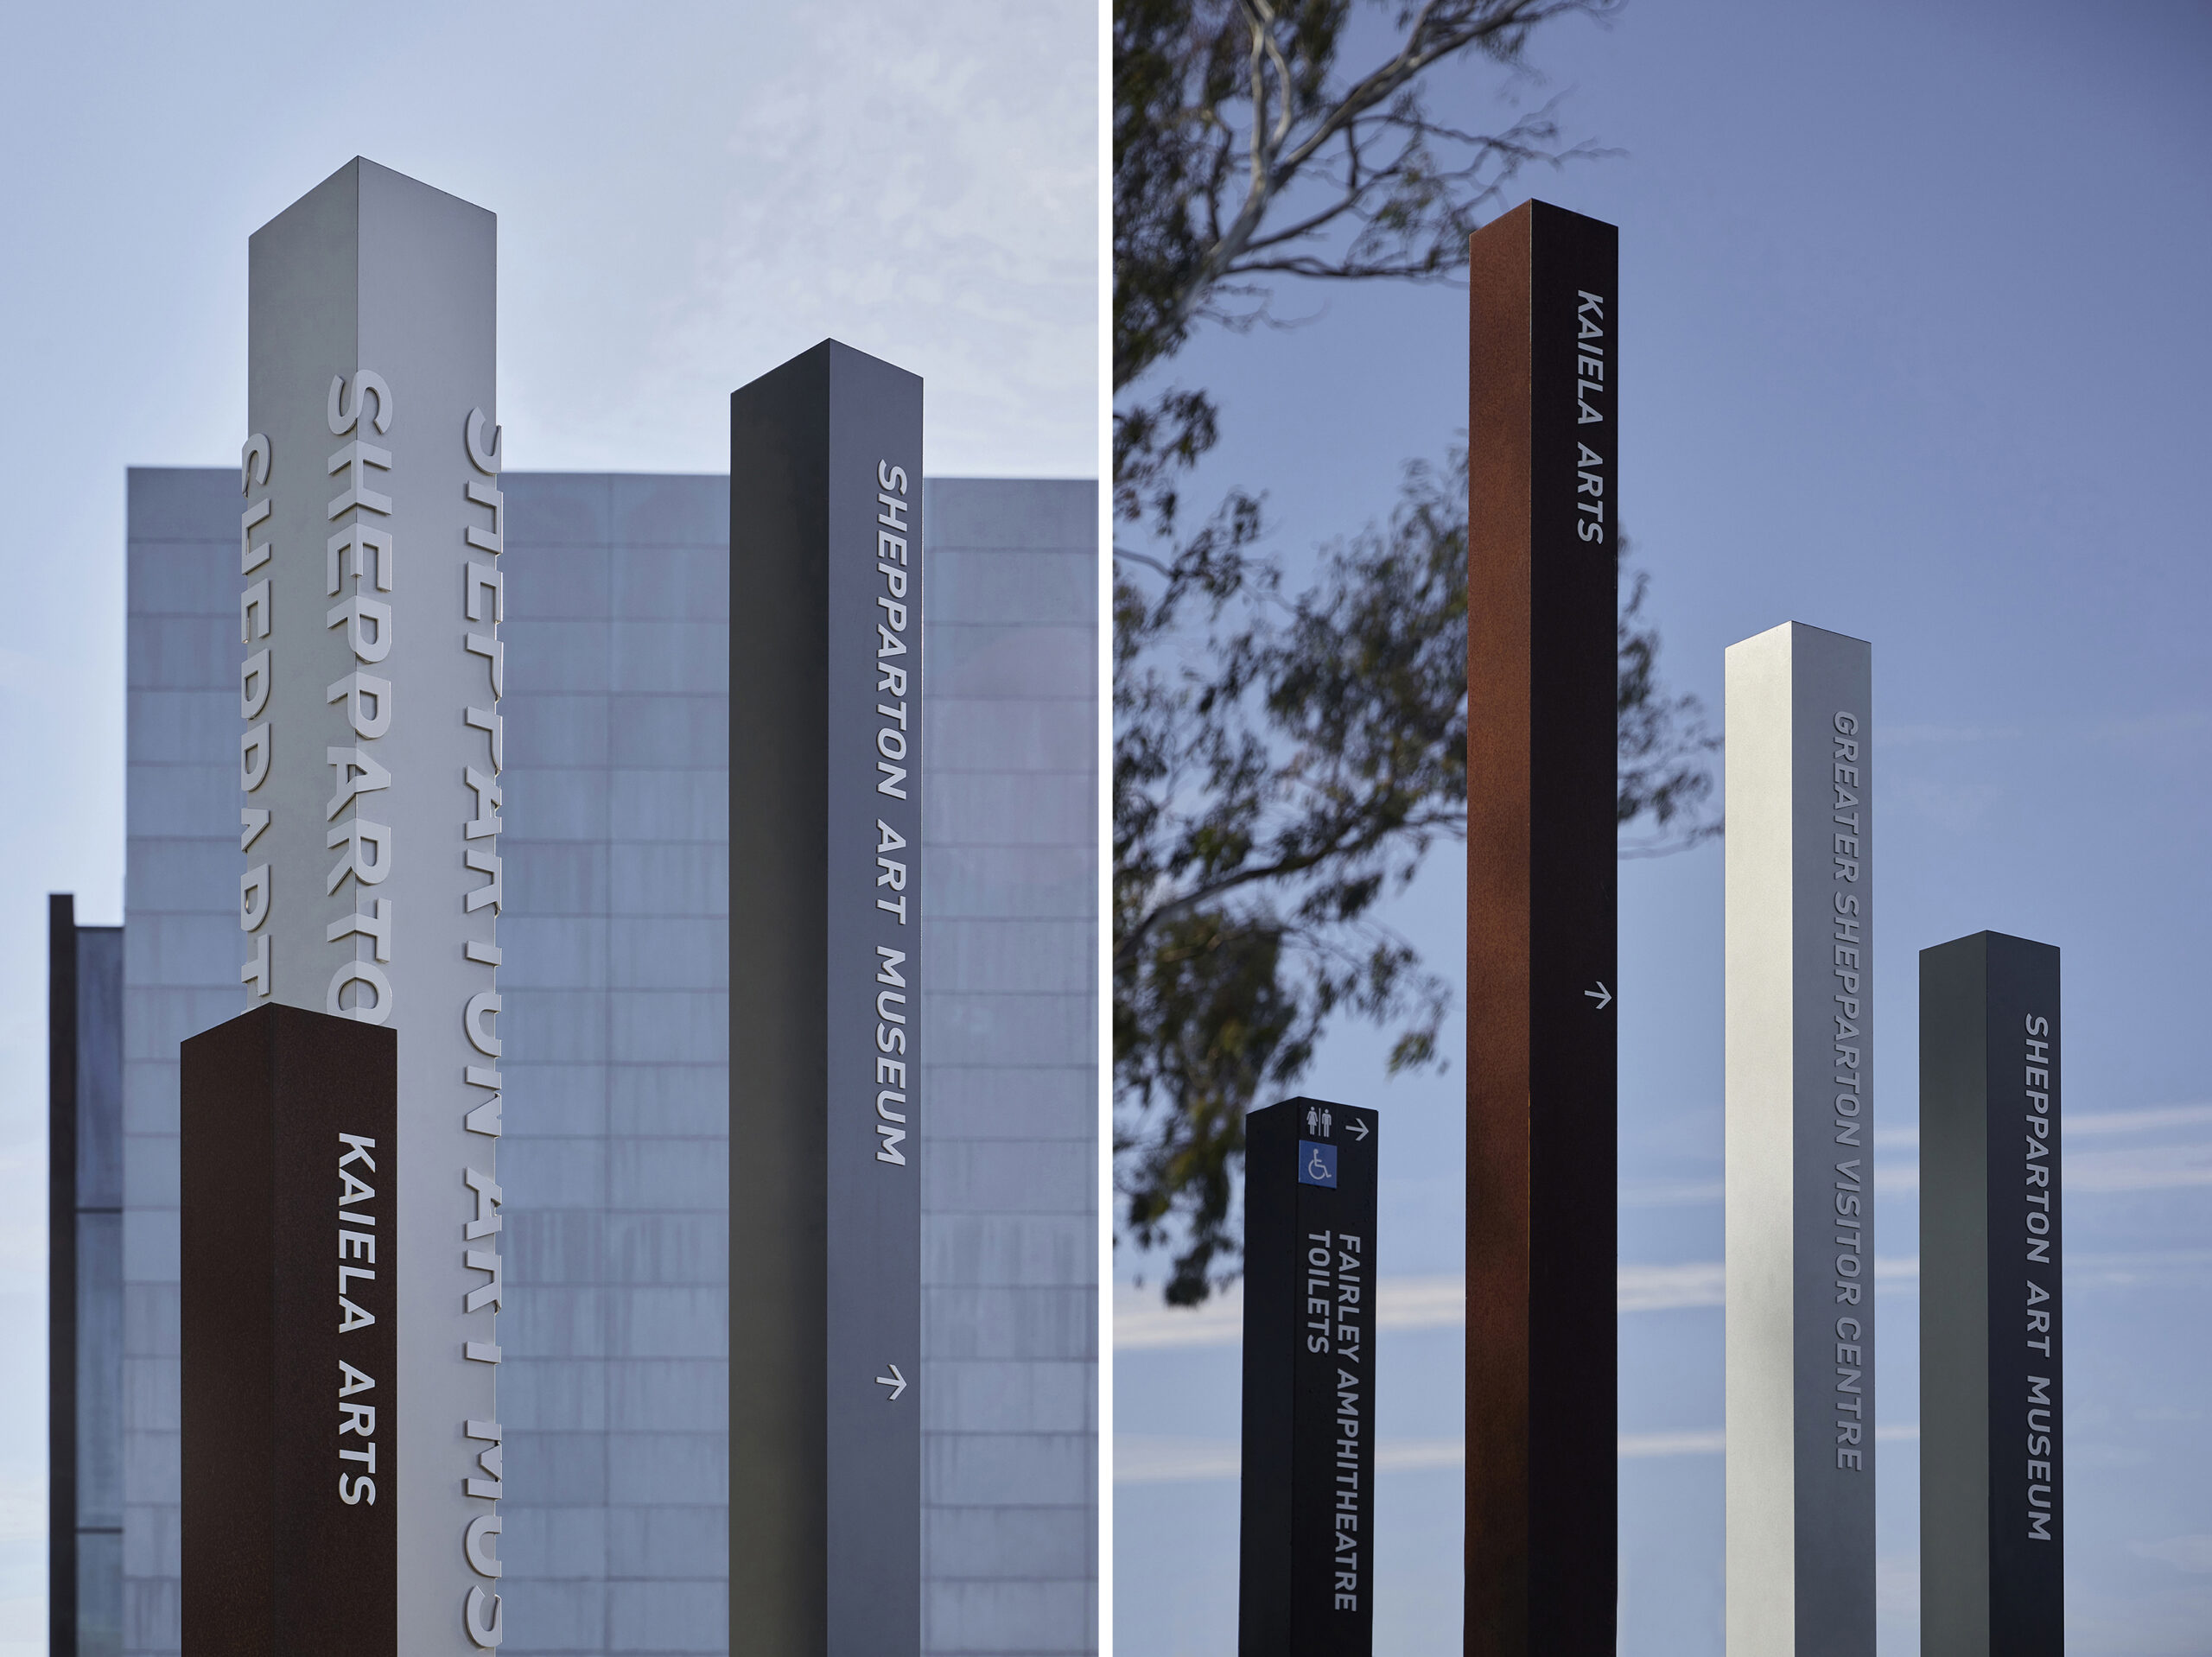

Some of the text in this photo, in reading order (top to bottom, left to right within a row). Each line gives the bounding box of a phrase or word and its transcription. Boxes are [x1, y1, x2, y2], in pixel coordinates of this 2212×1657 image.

[1578, 289, 1604, 544] KAIELA ARTS
[875, 459, 908, 1167] SHEPPARTON ART MUSEUM
[1833, 710, 1862, 1470] GREATER SHEPPARTON VISITOR CENTRE
[2024, 1013, 2052, 1542] SHEPPARTON ART MUSEUM
[339, 1133, 376, 1507] KAIELA ARTS
[1306, 1230, 1331, 1354] TOILETS
[1334, 1233, 1361, 1612] FAIRLEY AMPHITHEATRE
